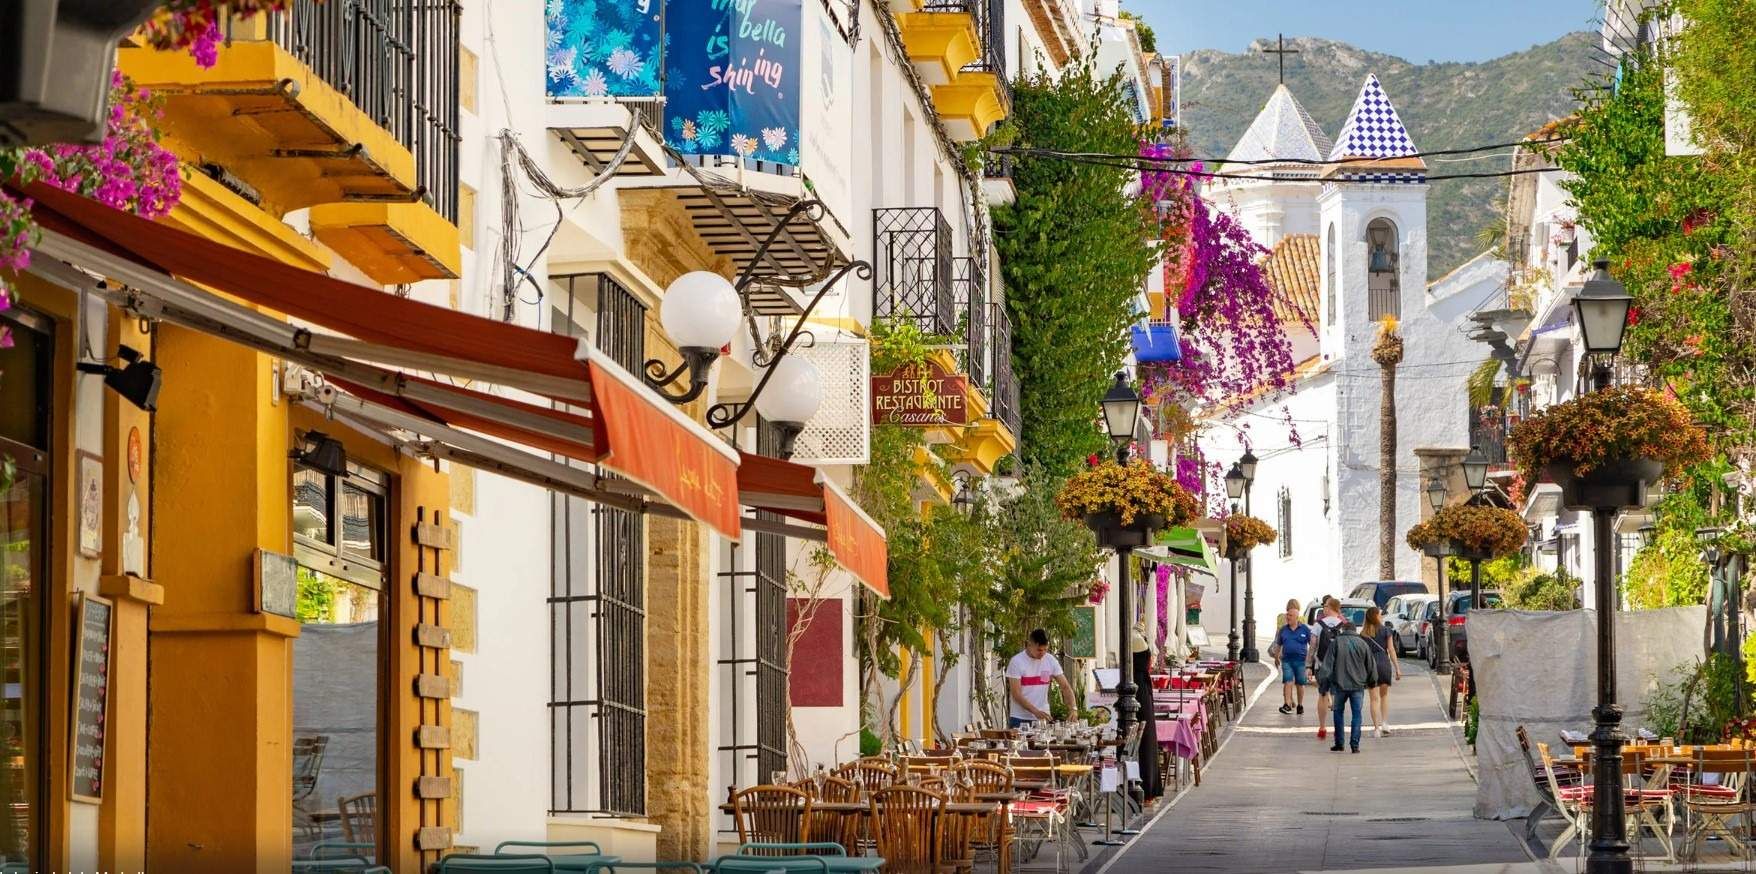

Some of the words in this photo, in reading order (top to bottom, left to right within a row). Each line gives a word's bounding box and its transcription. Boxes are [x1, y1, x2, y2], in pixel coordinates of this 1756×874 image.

[739, 14, 786, 48] bella
[706, 23, 729, 60] is
[893, 379, 945, 394] BISTROT
[876, 395, 962, 409] RESTAURANTE
[889, 406, 950, 423] Casans
